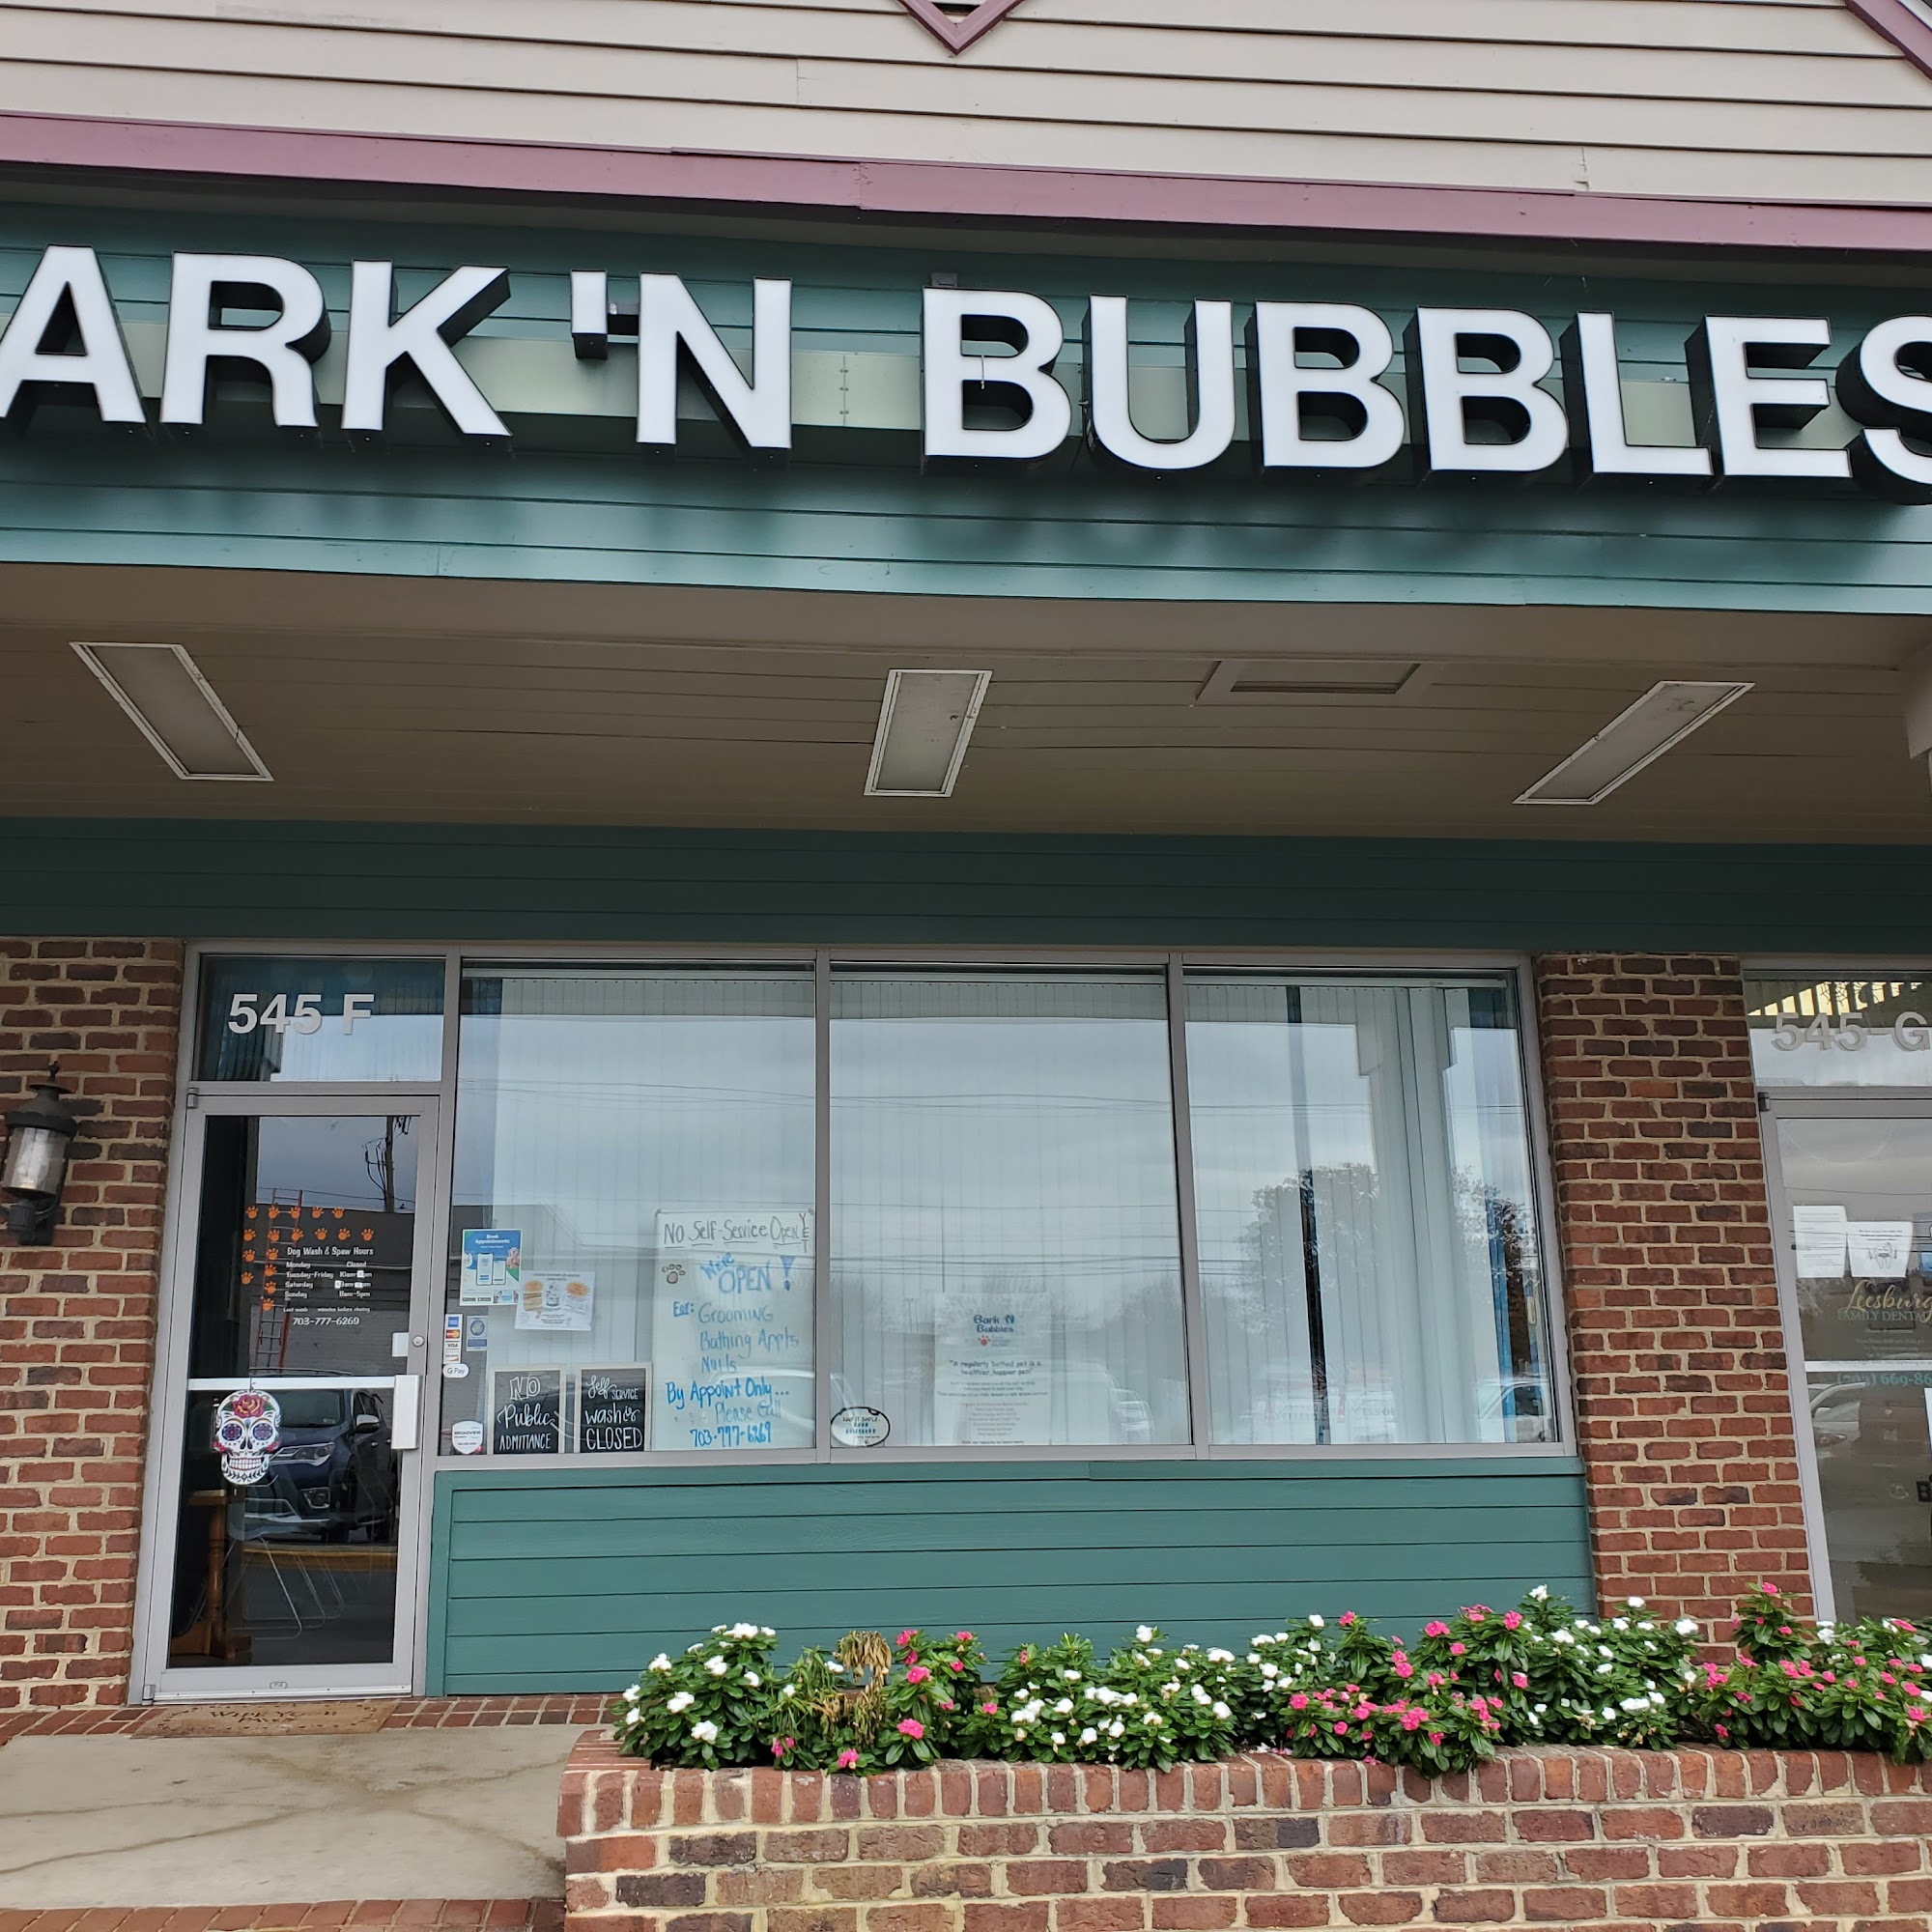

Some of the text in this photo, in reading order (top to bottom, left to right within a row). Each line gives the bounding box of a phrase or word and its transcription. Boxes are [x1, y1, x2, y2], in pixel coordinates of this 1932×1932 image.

[0, 244, 510, 436] ARK
[922, 286, 1932, 485] BUBBLES
[228, 993, 375, 1035] 545 F
[664, 1222, 685, 1245] NO
[287, 1246, 374, 1257] Dog Wash & Spaw Hours
[285, 1280, 314, 1289] Saturday
[286, 1270, 334, 1279] Tuesday-Friday
[284, 1290, 308, 1298] Sunday
[1839, 1279, 1932, 1323] Leesburg
[293, 1317, 360, 1325] 703-777-6269
[974, 1314, 1000, 1324] Bark
[977, 1324, 1014, 1333] Bubbles
[699, 1330, 752, 1359] Bathing
[454, 1367, 466, 1376] Pay
[509, 1375, 541, 1401] NO
[585, 1374, 639, 1401] Self SERVICE
[666, 1380, 686, 1411] By
[497, 1403, 555, 1429] Public
[498, 1433, 552, 1450] ADMITTANCE
[585, 1427, 643, 1450] CLOSED
